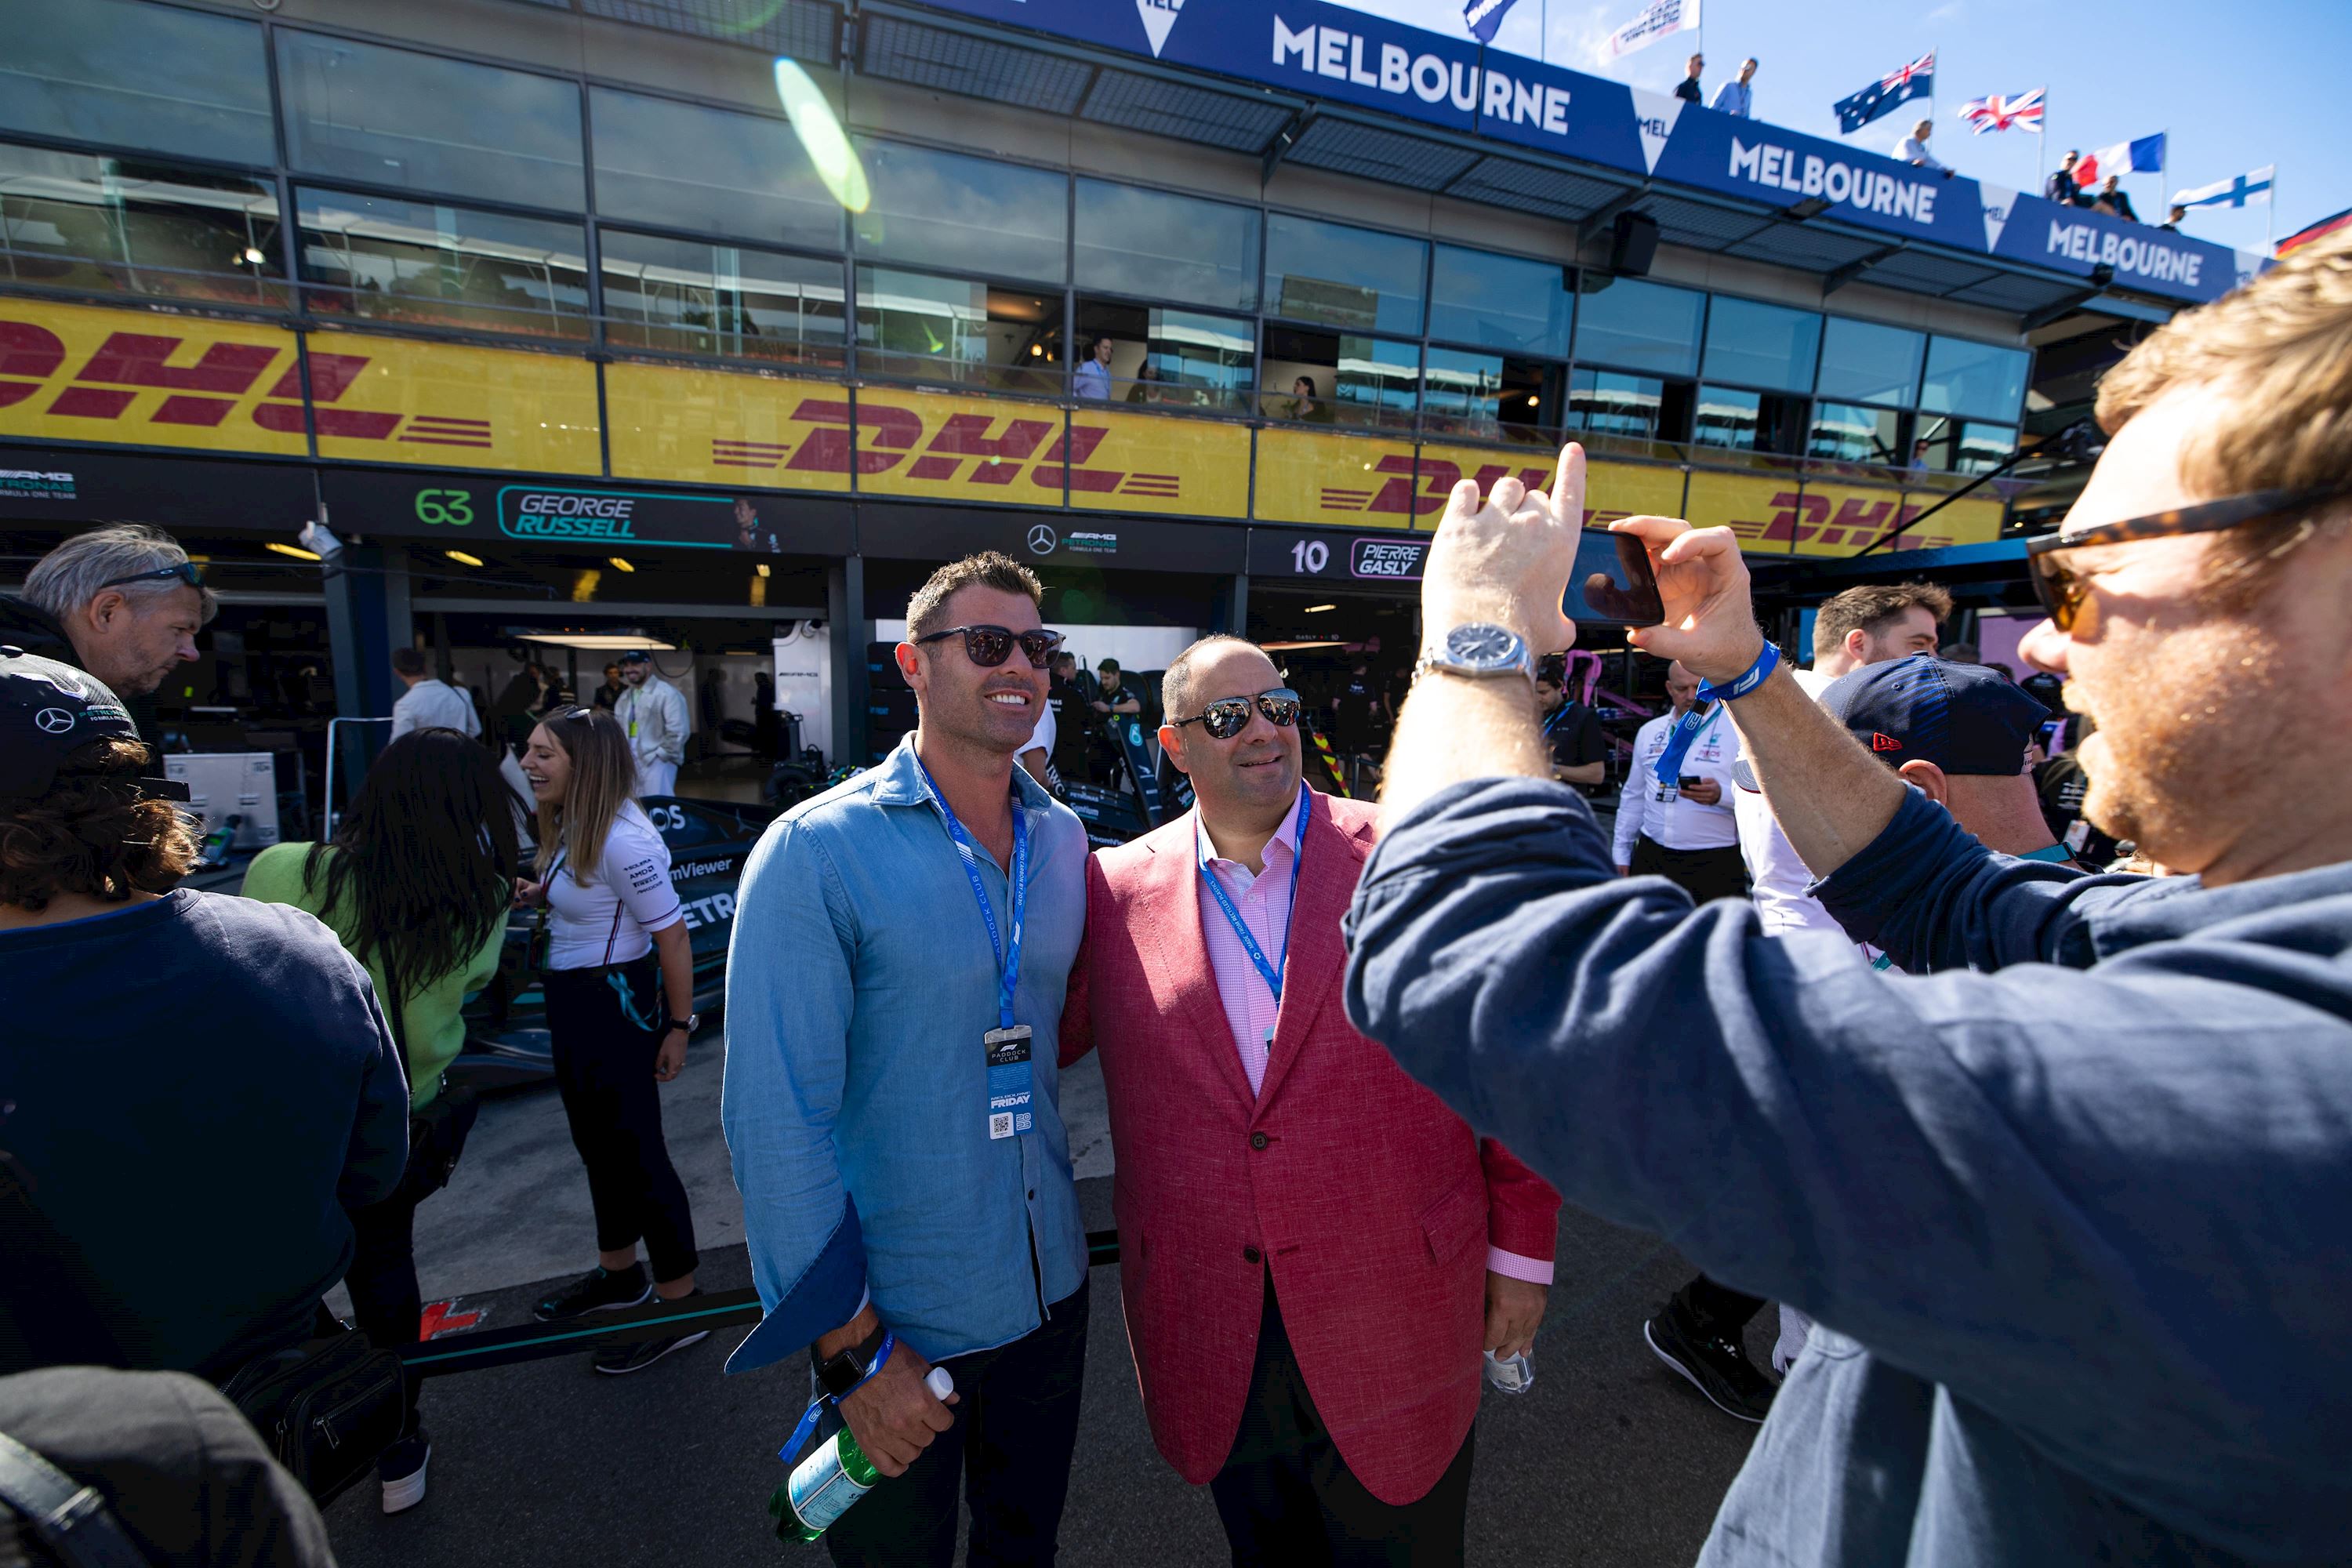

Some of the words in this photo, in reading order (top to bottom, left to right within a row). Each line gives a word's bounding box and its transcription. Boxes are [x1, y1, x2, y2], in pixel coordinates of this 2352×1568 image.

[1272, 13, 1570, 136] MELBOURNE
[1728, 136, 1937, 224] MELBOURNE
[2046, 218, 2204, 287] MELBOURNE
[784, 398, 1126, 493] DHL
[415, 488, 474, 526] 63
[520, 494, 636, 518] GEORGE
[1762, 492, 1926, 550] DHL
[515, 514, 636, 538] RUSSELL
[1291, 539, 1330, 574] 10
[1359, 559, 1413, 575] GASLY
[1363, 544, 1421, 561] PIERRE
[1046, 764, 1065, 797] IWC
[971, 875, 986, 904] CLUB
[992, 1049, 1026, 1059] PADDOCK
[990, 1094, 1031, 1109] FRIDAY
